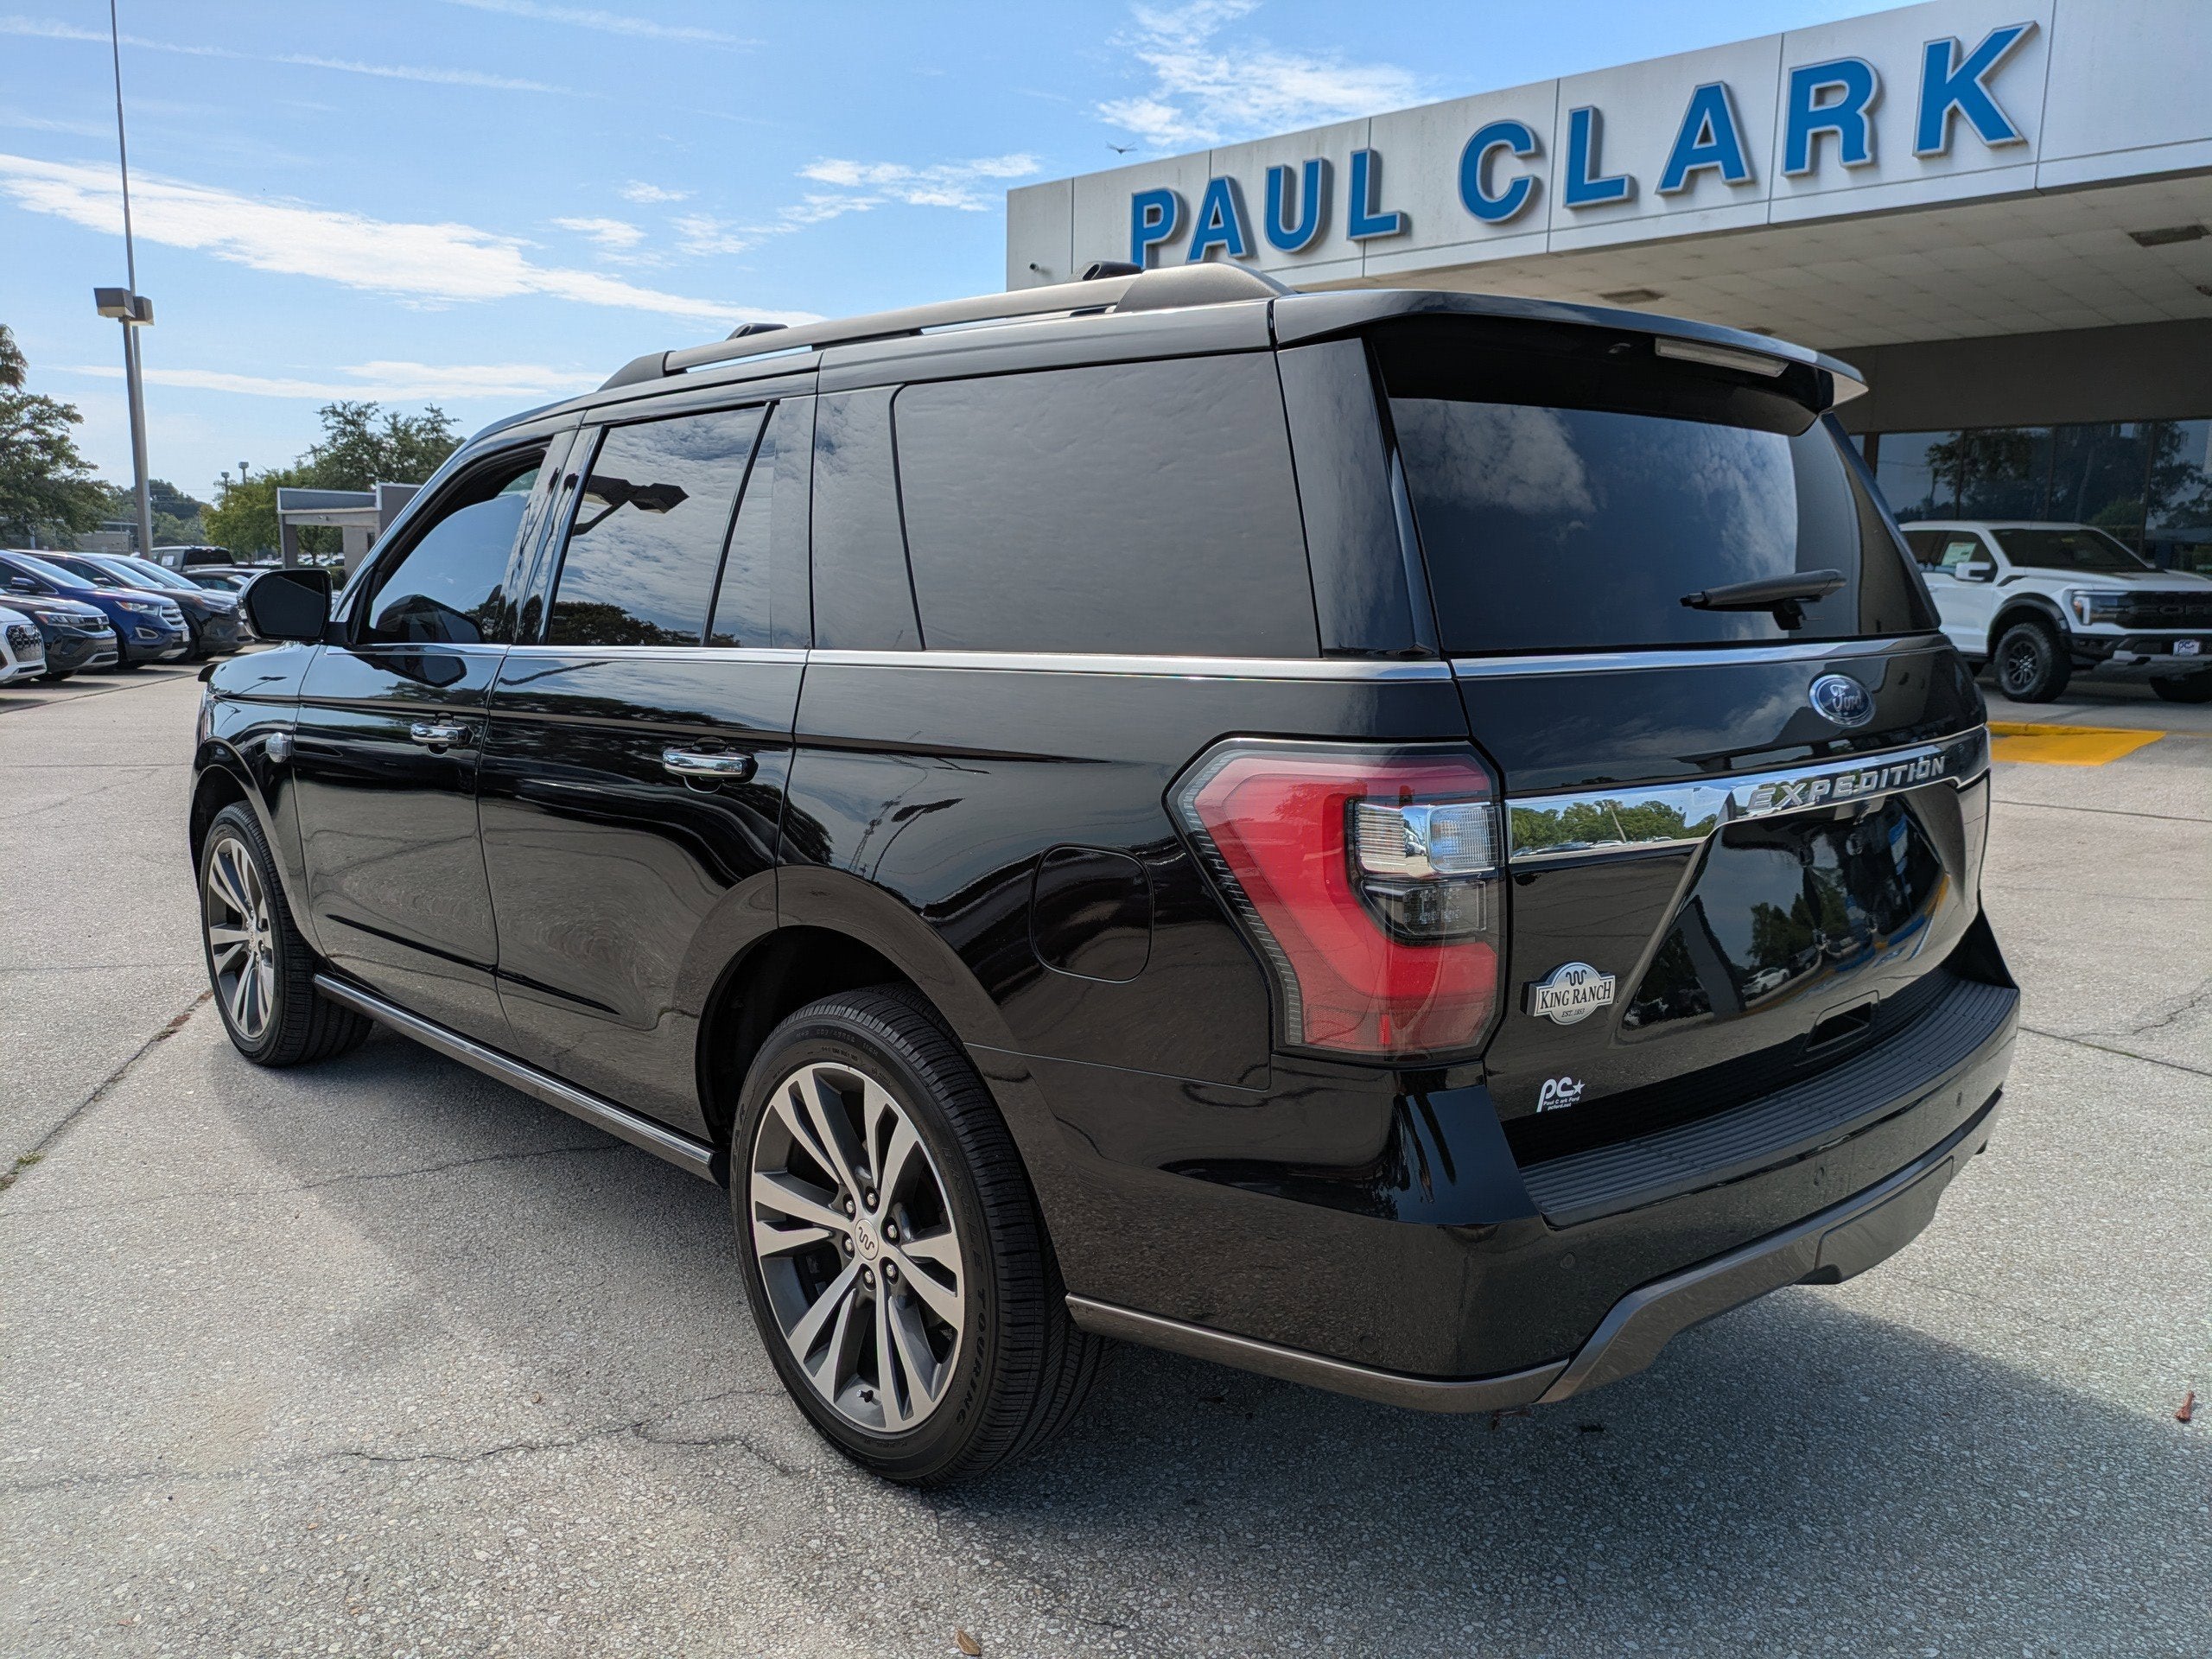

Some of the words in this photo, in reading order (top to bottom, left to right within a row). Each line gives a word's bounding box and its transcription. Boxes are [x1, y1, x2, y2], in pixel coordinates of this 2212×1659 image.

[1131, 149, 1408, 270] PAUL
[1458, 20, 2039, 224] CLARK
[1829, 683, 1864, 712] Ford
[1746, 756, 1945, 813] EXPEDITION
[1540, 989, 1570, 1009] KING
[1572, 981, 1612, 1005] RANCH
[956, 1287, 987, 1426] TOURING
